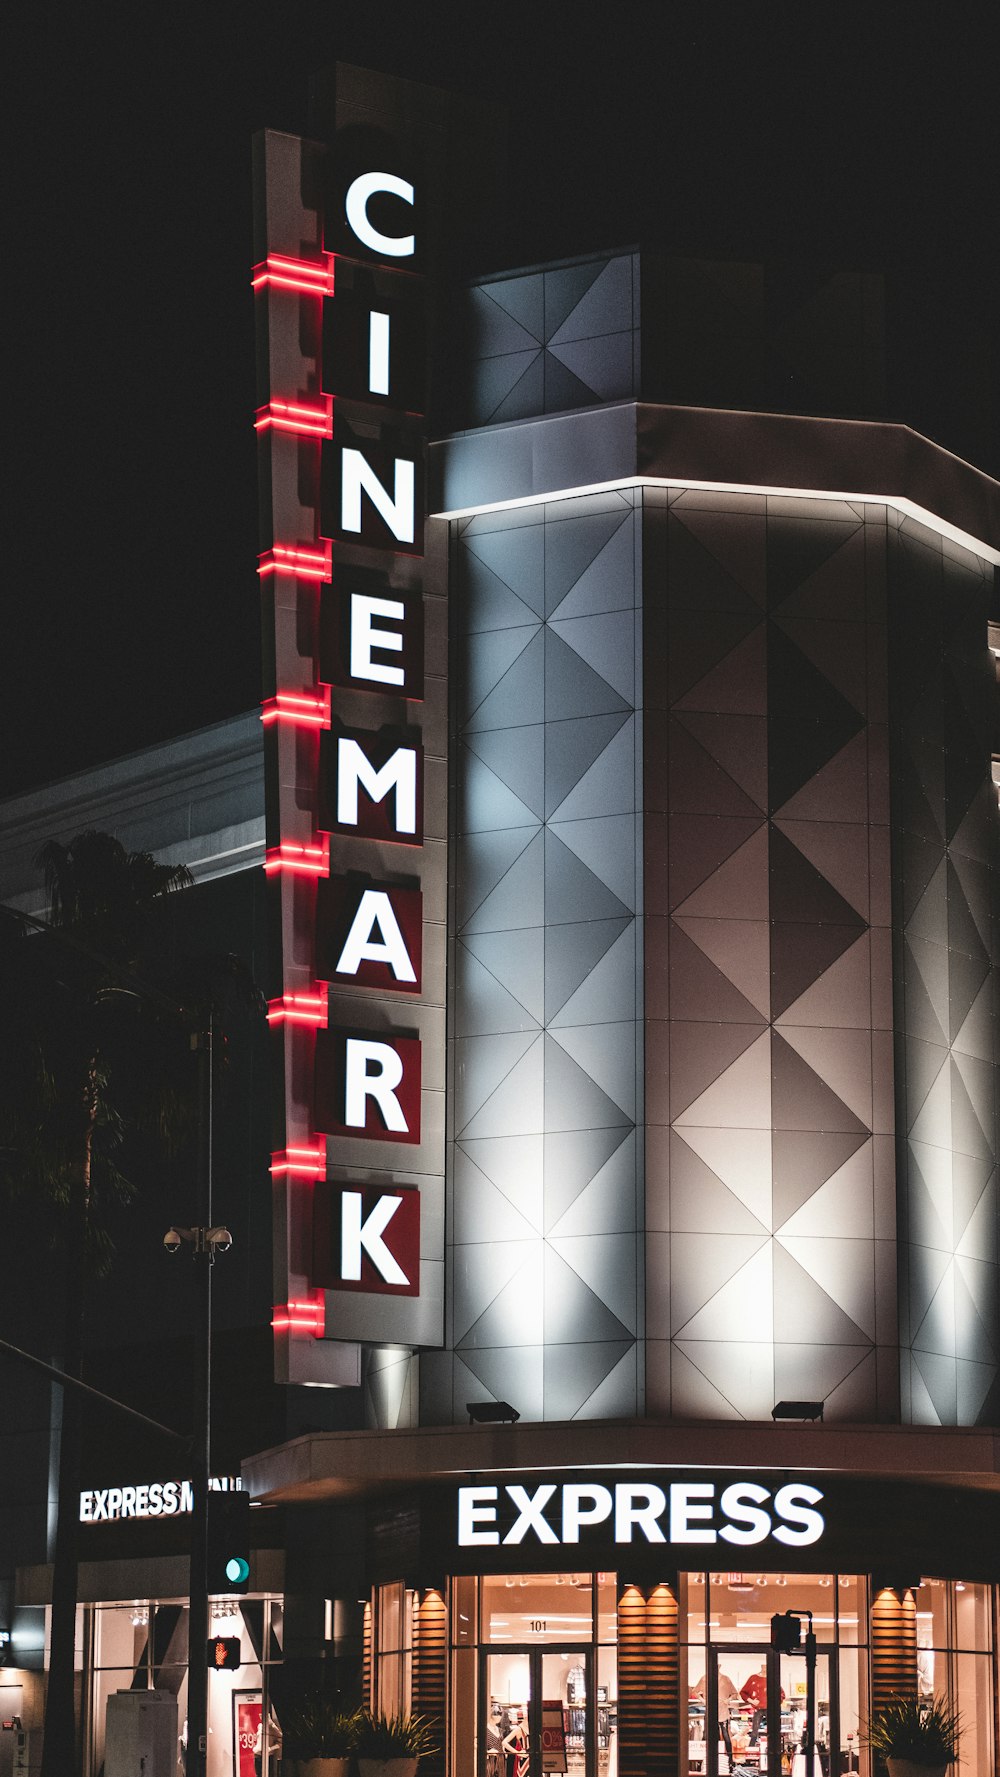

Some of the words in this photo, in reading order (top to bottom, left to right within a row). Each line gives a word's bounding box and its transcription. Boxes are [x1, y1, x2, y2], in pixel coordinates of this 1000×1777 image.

[336, 172, 416, 1285] CINEMARK
[79, 1482, 179, 1522] EXPRESS
[458, 1483, 825, 1546] EXPRESS
[530, 1620, 546, 1632] 101
